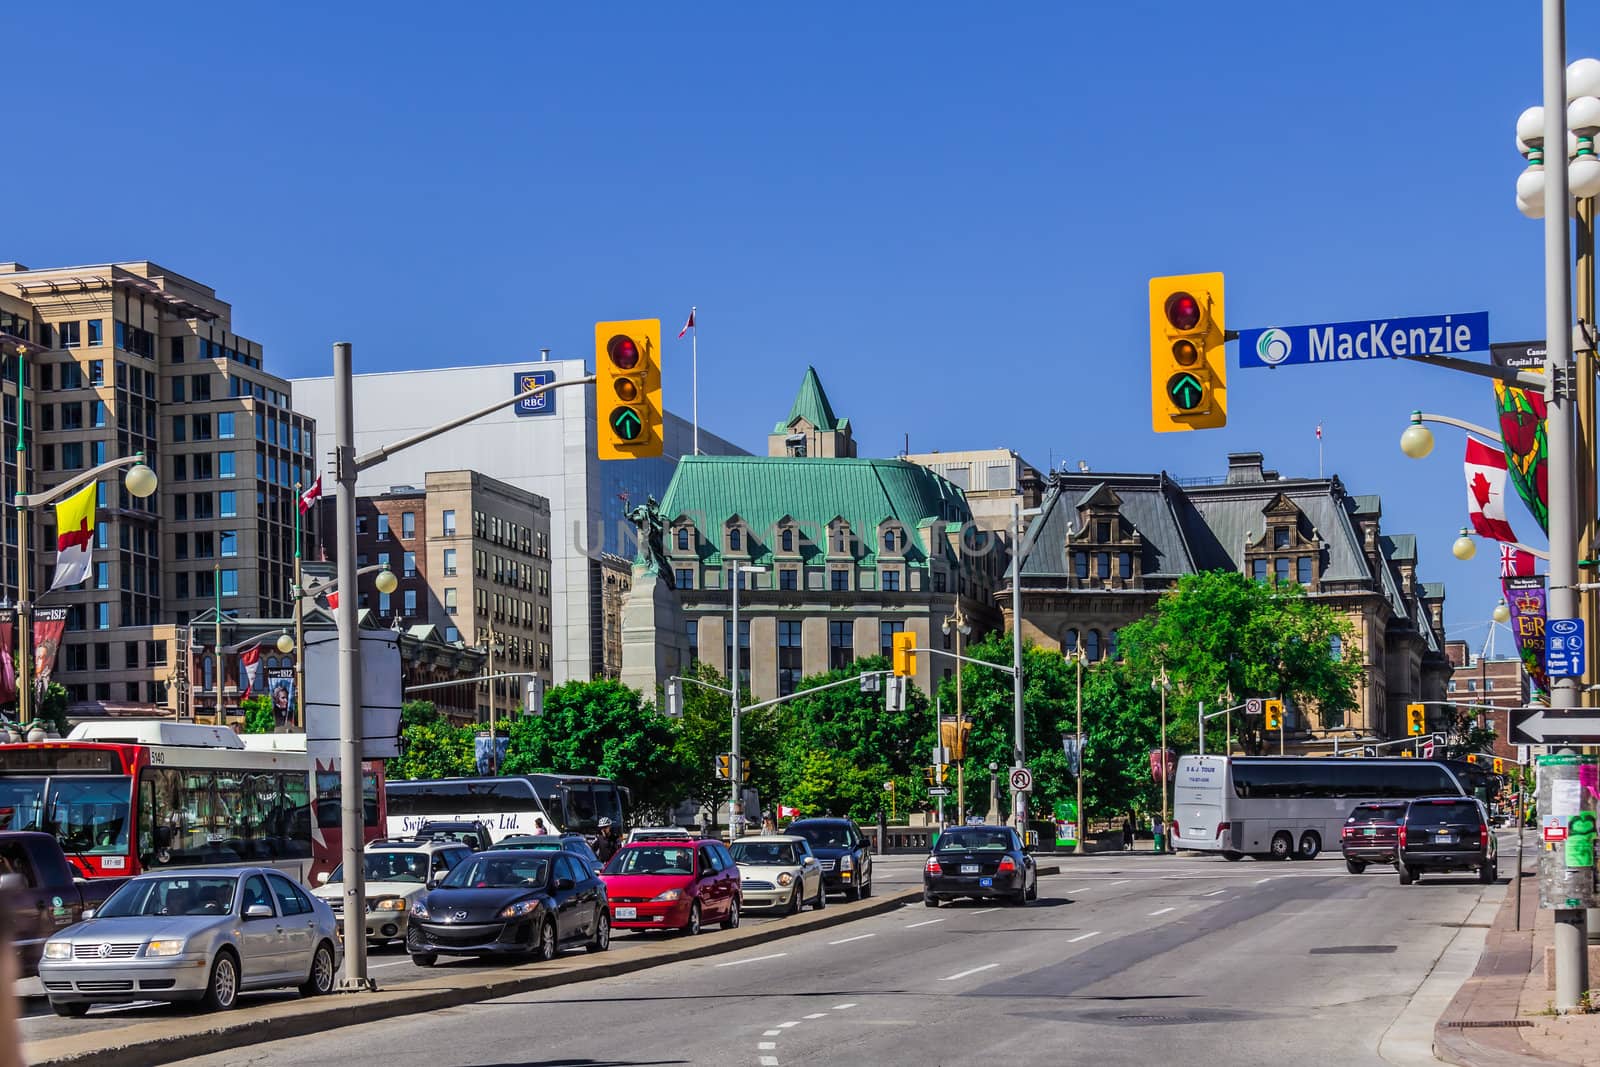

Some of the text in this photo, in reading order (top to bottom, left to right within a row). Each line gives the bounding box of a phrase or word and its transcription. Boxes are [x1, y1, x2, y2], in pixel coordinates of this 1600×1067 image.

[1308, 315, 1472, 362] MacKenzie
[1506, 358, 1532, 367] Capital
[524, 398, 544, 407] RBC
[1522, 639, 1544, 649] 1952
[151, 751, 165, 764] 5140
[499, 813, 520, 830] Ltd.
